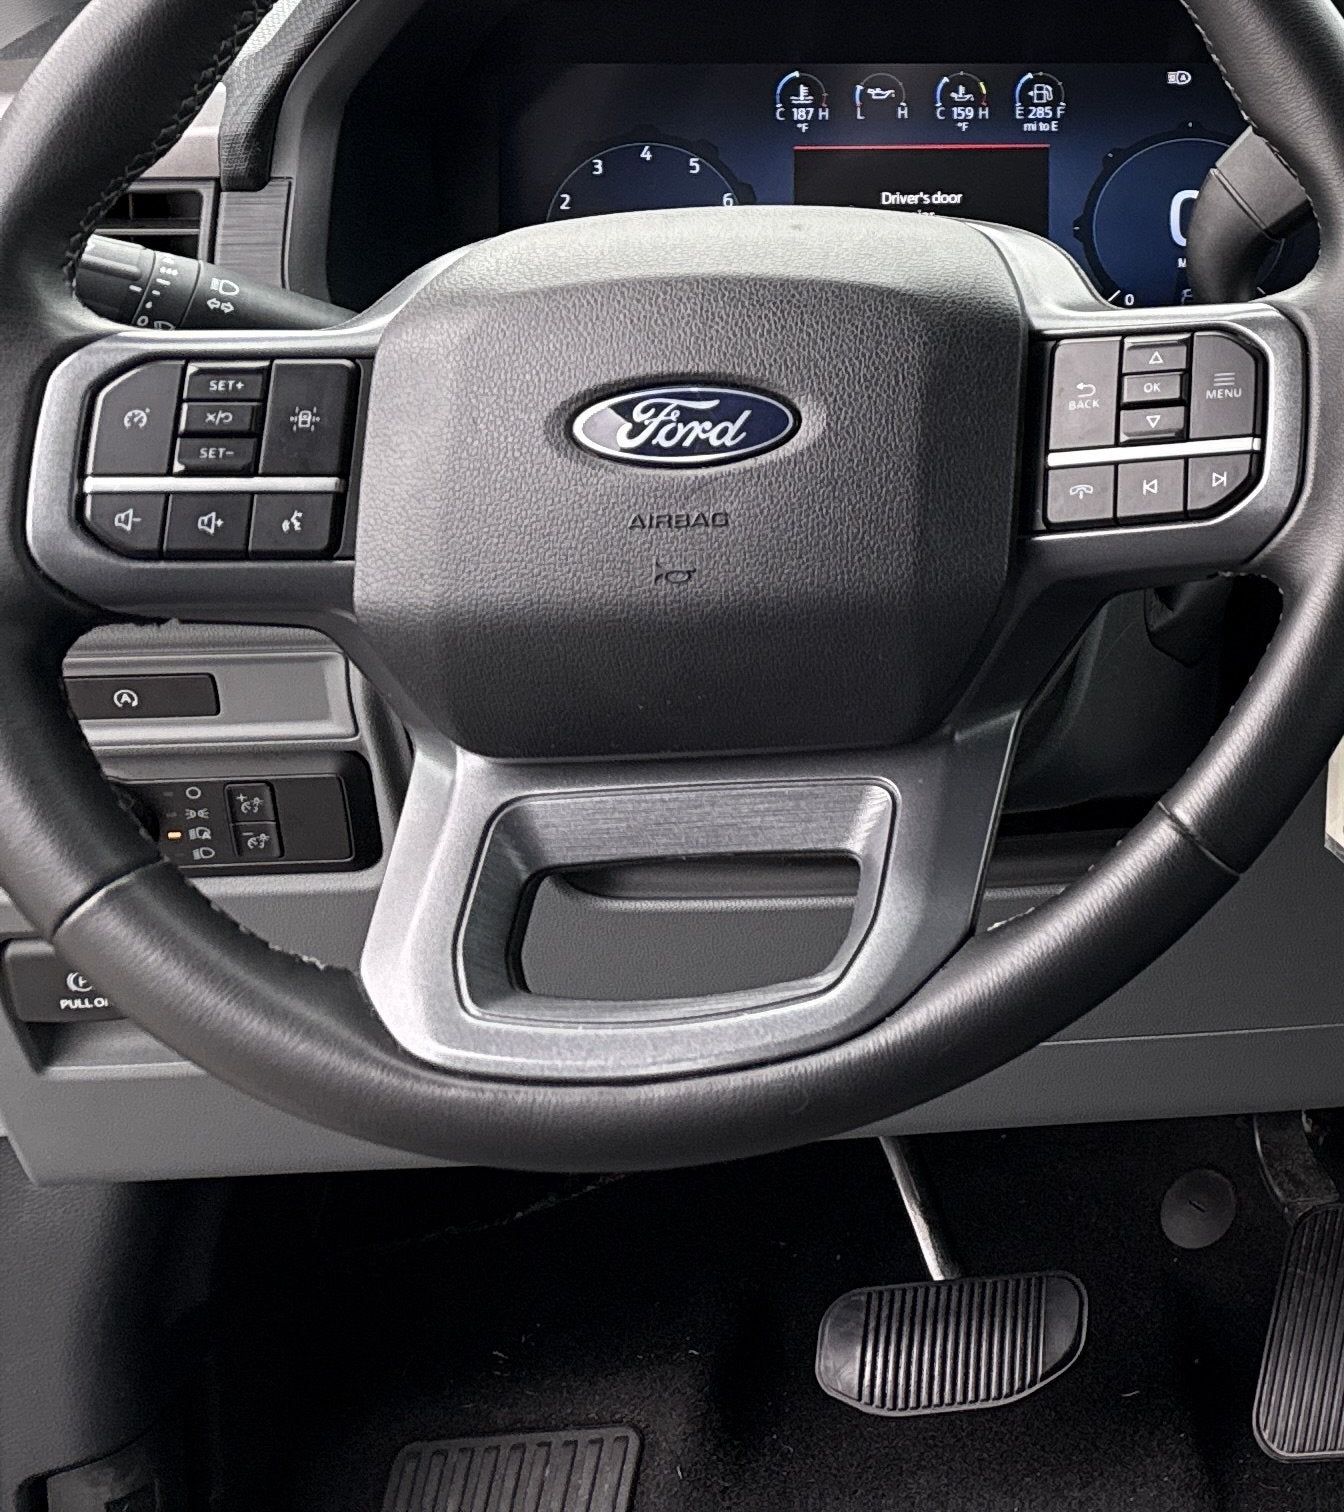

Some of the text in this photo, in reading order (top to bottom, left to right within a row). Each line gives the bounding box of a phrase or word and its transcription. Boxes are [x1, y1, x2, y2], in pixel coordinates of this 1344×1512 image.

[775, 107, 829, 121] C 187 H
[856, 107, 865, 120] L
[897, 106, 908, 119] H
[936, 107, 989, 120] C 159 H
[1015, 106, 1066, 120] E 285 F
[1023, 121, 1059, 132] mi to E
[640, 145, 653, 161] 4
[592, 159, 603, 175] 3
[689, 157, 700, 174] 5
[559, 194, 571, 209] 2
[722, 192, 734, 207] 6
[880, 190, 963, 206] Driver's door
[1124, 294, 1134, 306] 0
[208, 379, 245, 392] SET+
[1143, 382, 1161, 394] OK
[1205, 387, 1242, 400] MENU
[1068, 399, 1100, 411] BACK
[616, 396, 752, 450] Ford
[199, 447, 235, 460] SET-
[628, 511, 729, 530] AIRBAG
[59, 997, 93, 1009] PULL
